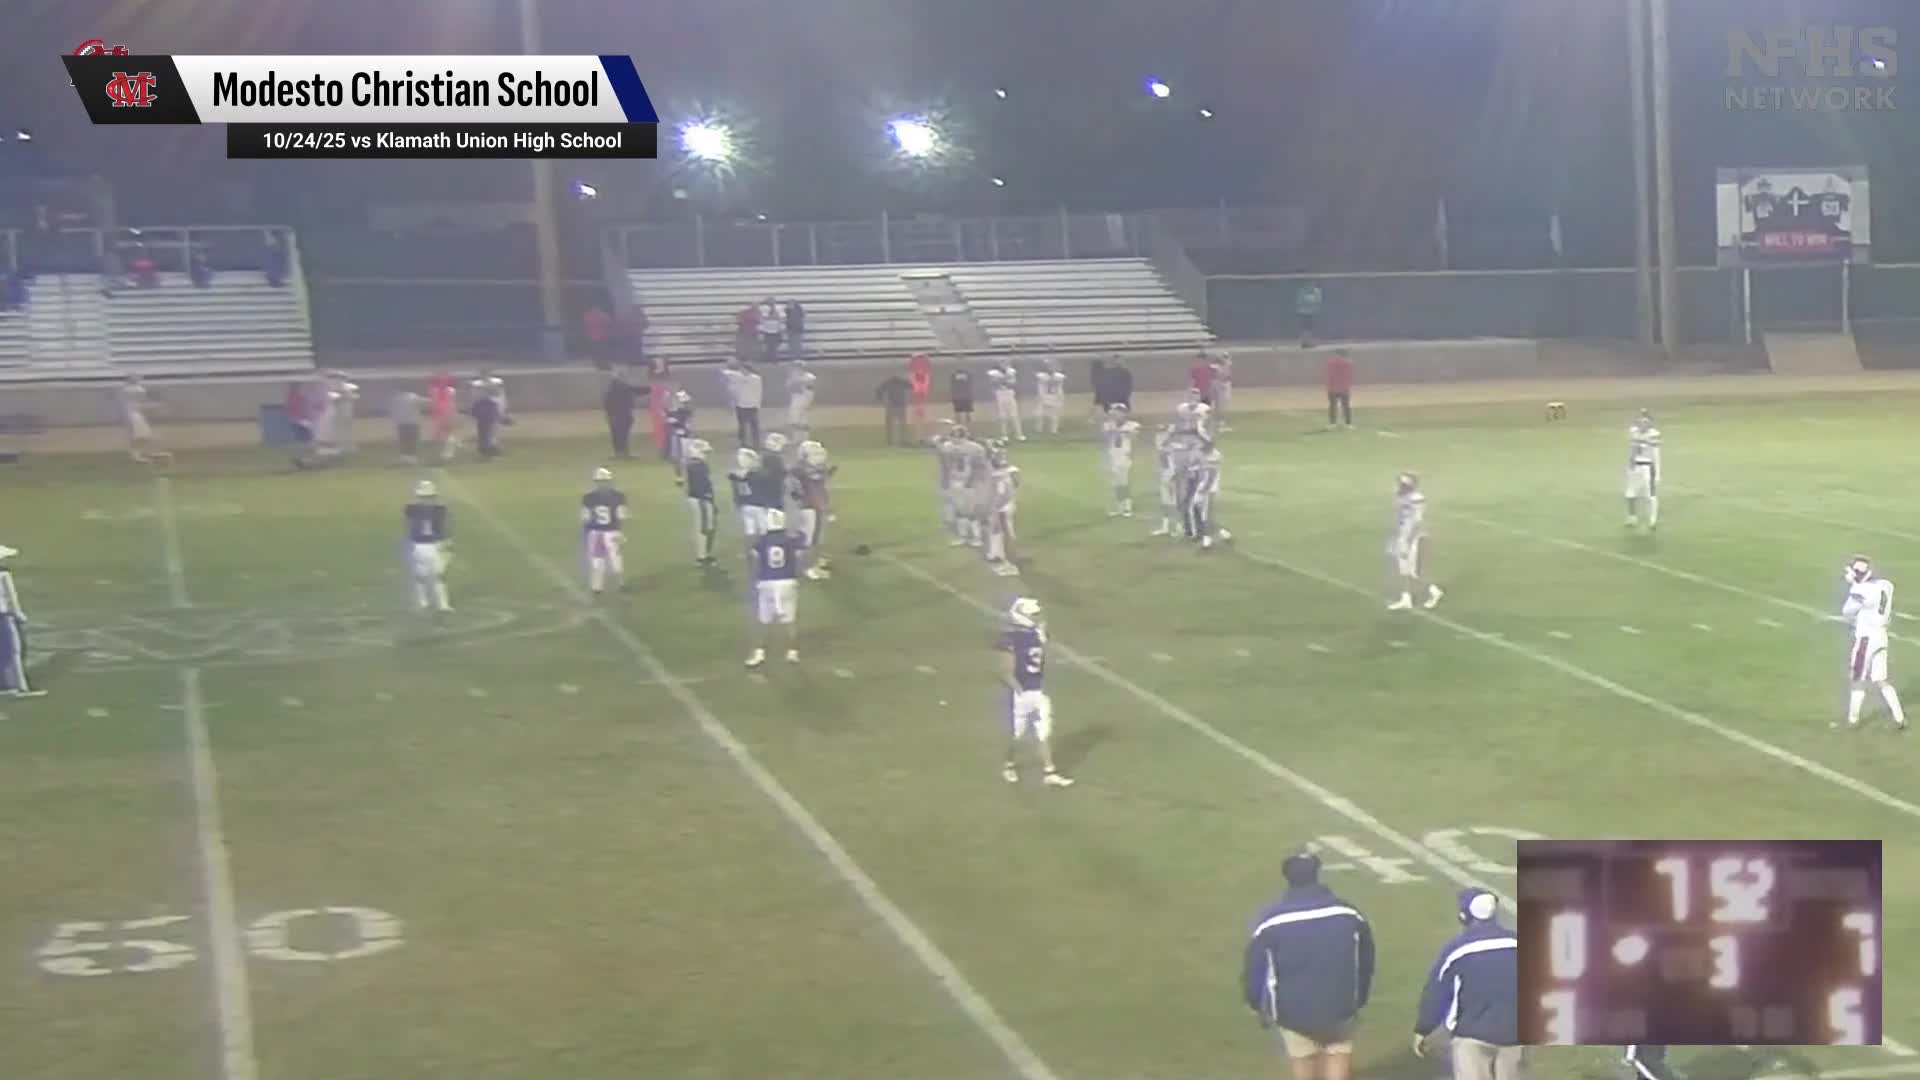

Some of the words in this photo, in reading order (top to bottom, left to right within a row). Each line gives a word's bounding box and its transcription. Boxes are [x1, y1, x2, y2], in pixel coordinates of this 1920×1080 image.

[767, 545, 785, 569] 8
[1025, 646, 1043, 674] 3
[36, 905, 407, 976] 50
